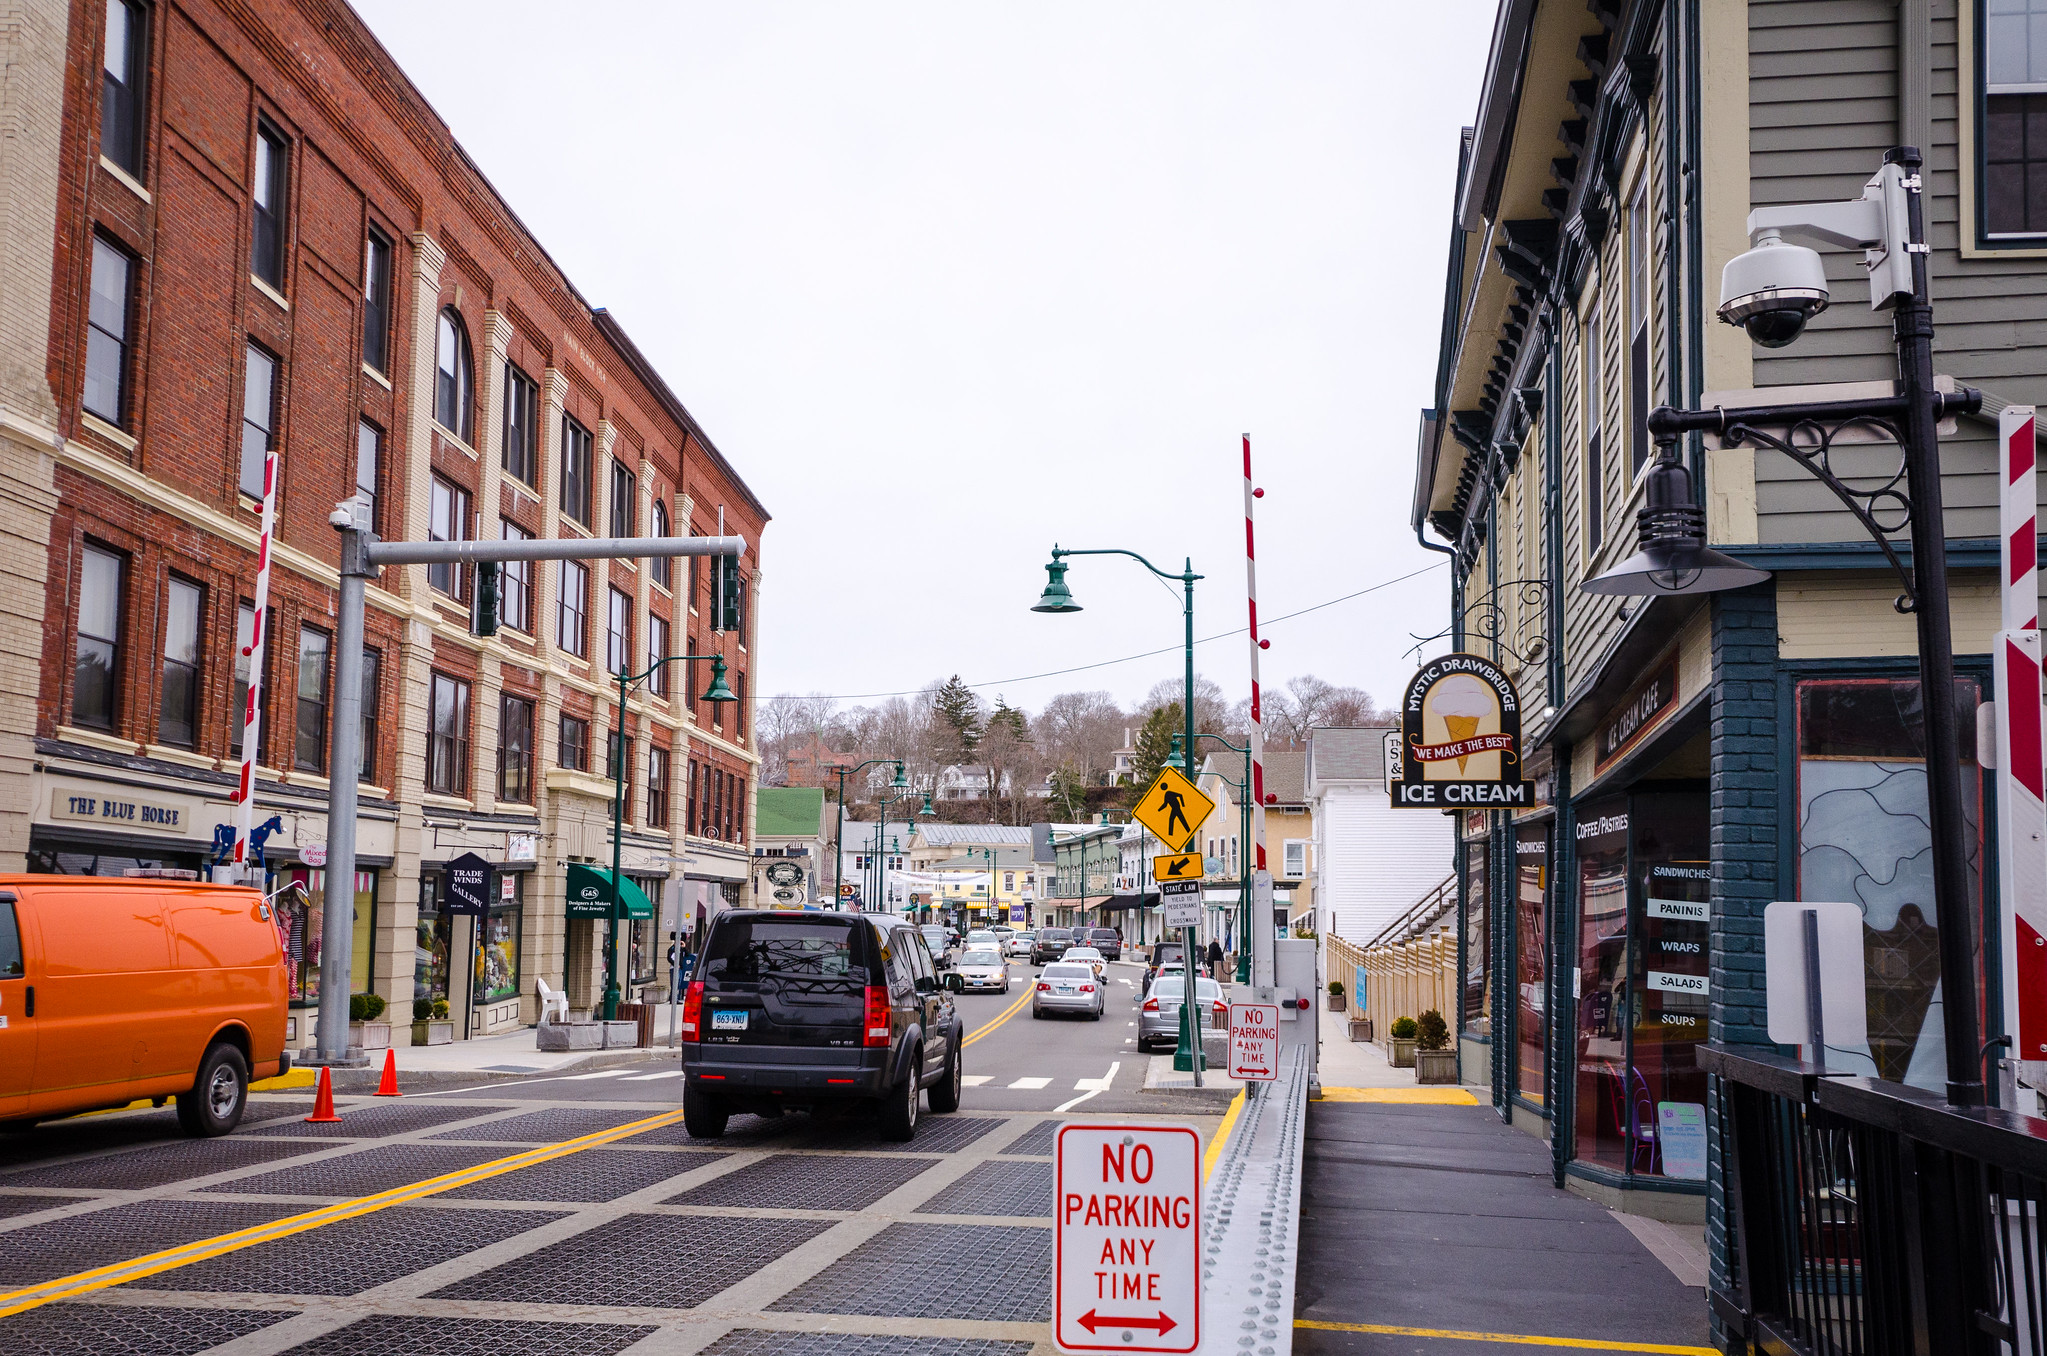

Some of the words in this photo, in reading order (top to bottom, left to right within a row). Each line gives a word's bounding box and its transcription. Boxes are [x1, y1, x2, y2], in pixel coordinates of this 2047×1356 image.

[1408, 667, 1440, 711] MYSTIC
[1441, 659, 1516, 712] DRAWBRIDGE
[1607, 723, 1617, 753] ICE
[1619, 701, 1639, 742] CREAM
[1641, 680, 1659, 720] CAFE
[1434, 743, 1464, 758] MAKE
[1465, 740, 1484, 751] THE
[1401, 784, 1435, 802] ICE
[1444, 784, 1525, 802] CREAM
[68, 797, 95, 815] THE
[102, 800, 135, 820] BLUE
[141, 805, 179, 825] HORSE
[305, 849, 327, 857] Mixed
[1516, 840, 1546, 854] SANDWICHES
[308, 856, 321, 865] Bag
[1653, 866, 1710, 879] SANDWICHES
[452, 883, 483, 908] GALLERY
[1660, 903, 1703, 917] PANINIS
[1661, 941, 1700, 953] WRAPS
[1660, 976, 1703, 989] SALADS
[1245, 1010, 1263, 1024] NO
[1661, 1014, 1696, 1027] SOUPS
[1232, 1027, 1275, 1040] PARKING
[1244, 1042, 1263, 1051] ANY
[1242, 1052, 1265, 1063] TIME
[1103, 1143, 1153, 1184] NO
[1065, 1193, 1190, 1229] PARKING
[1100, 1238, 1155, 1266] ANY
[1094, 1272, 1161, 1301] TIME
